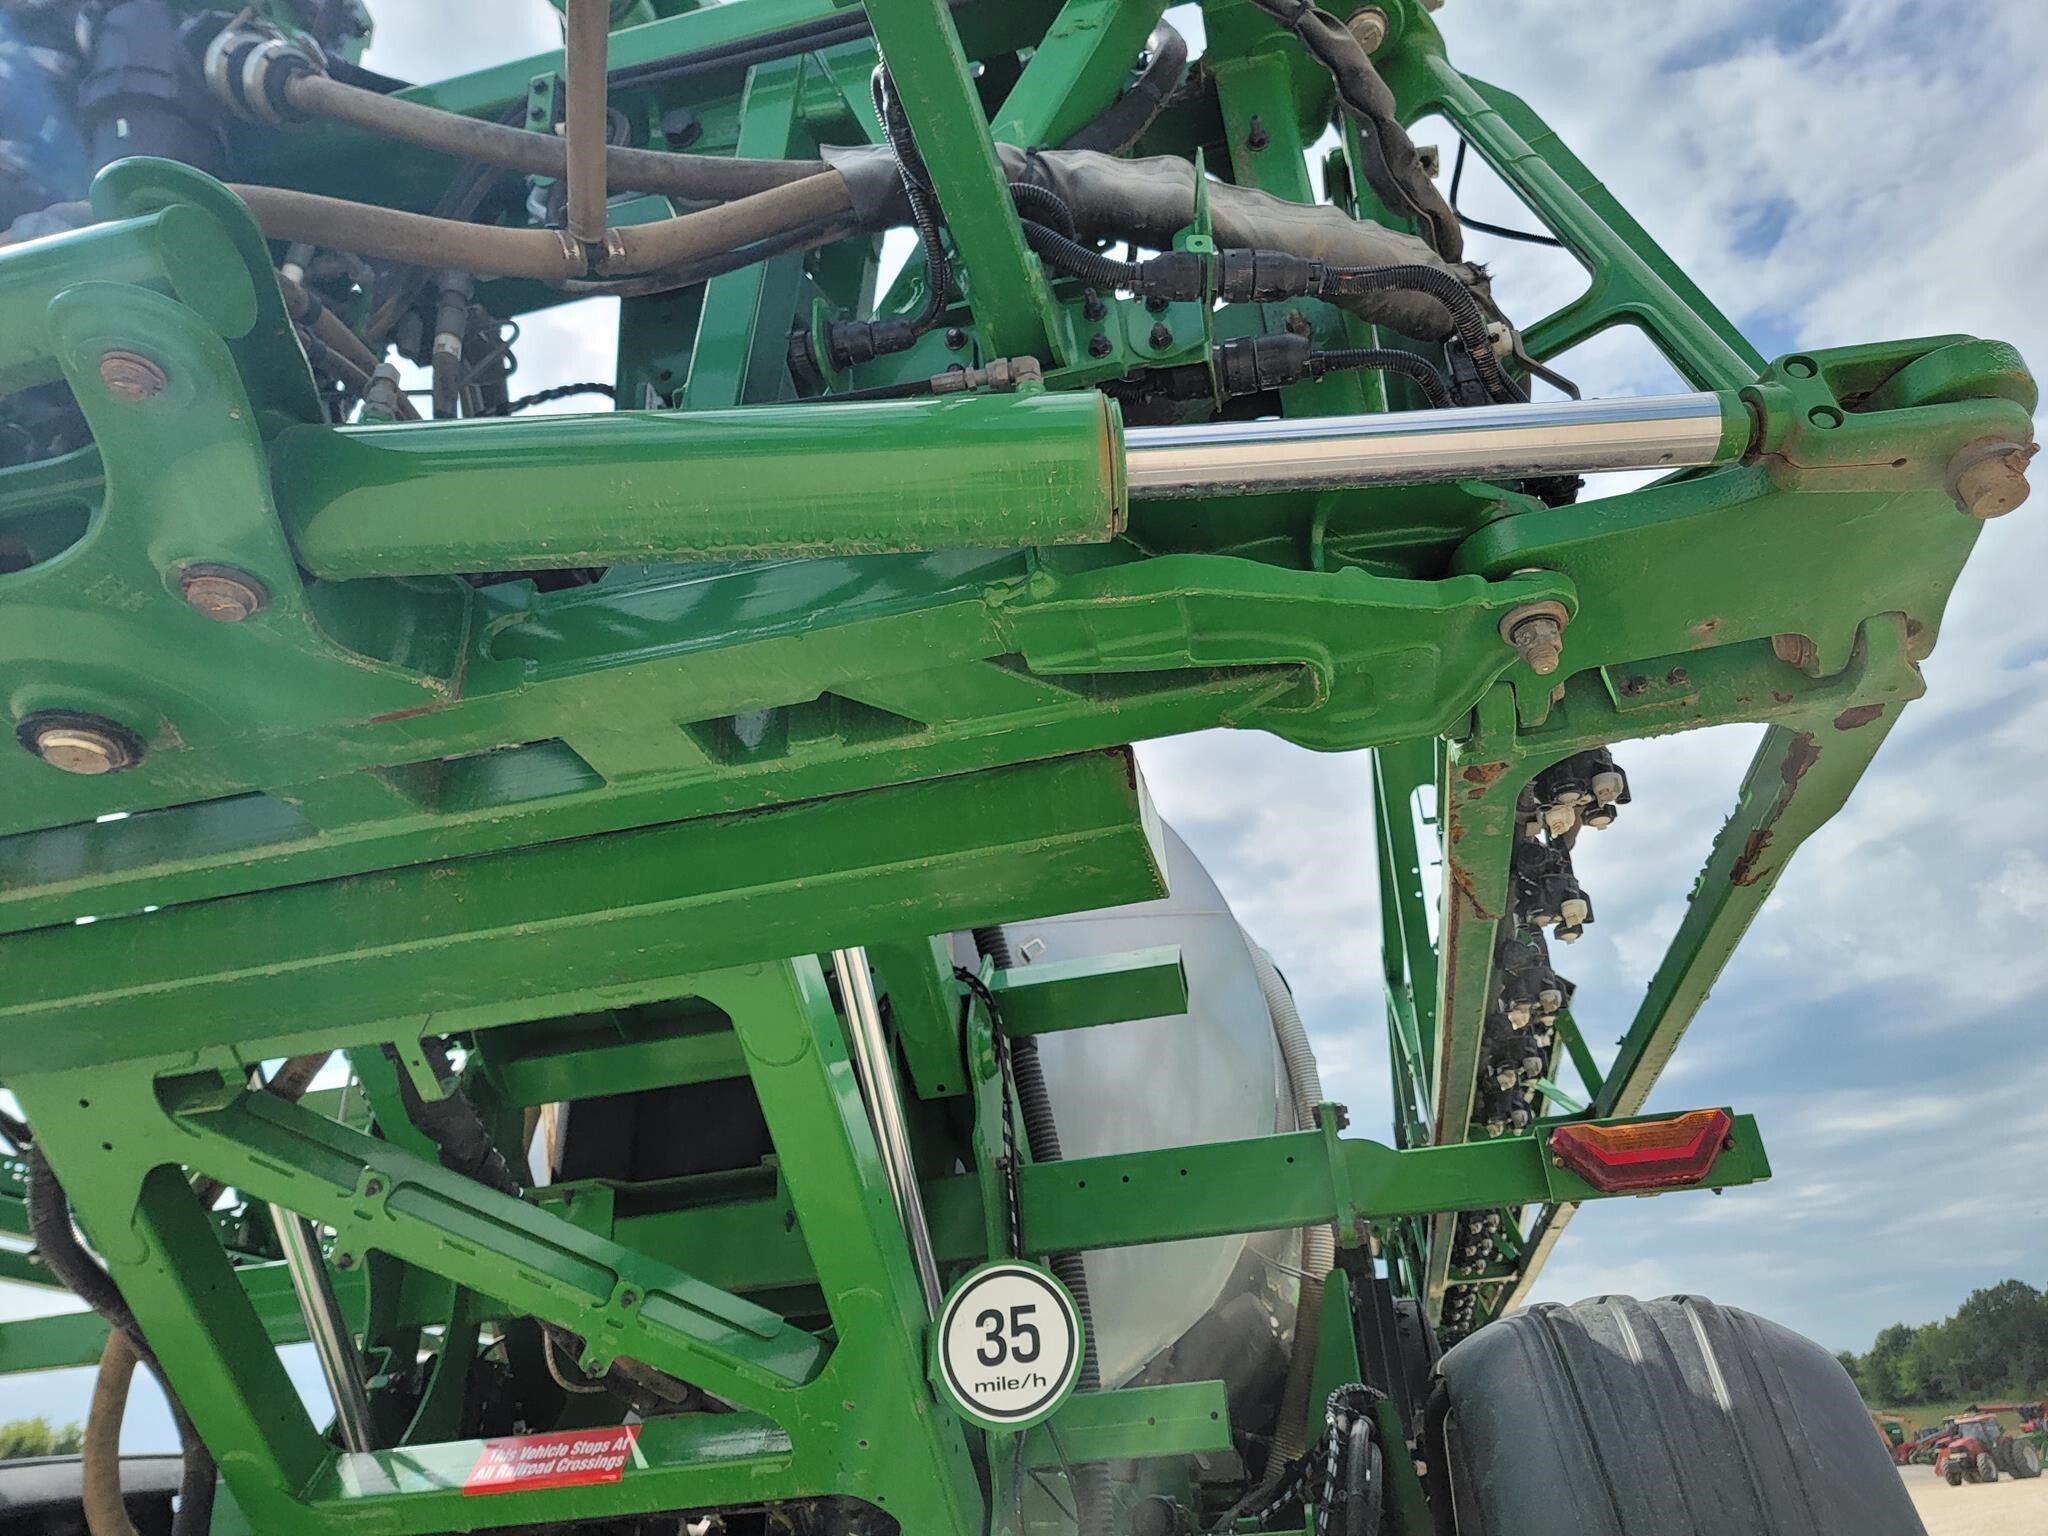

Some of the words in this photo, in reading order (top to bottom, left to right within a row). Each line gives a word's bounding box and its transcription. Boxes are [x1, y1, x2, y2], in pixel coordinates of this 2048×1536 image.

[975, 1304, 1041, 1367] 35
[975, 1373, 1047, 1394] mile/h
[489, 1448, 516, 1463] This
[519, 1443, 569, 1460] Vehicle
[570, 1439, 609, 1455] Stops
[611, 1437, 631, 1451] At
[474, 1467, 493, 1482] All
[495, 1460, 555, 1480] Railroad
[556, 1454, 625, 1473] Crossings
